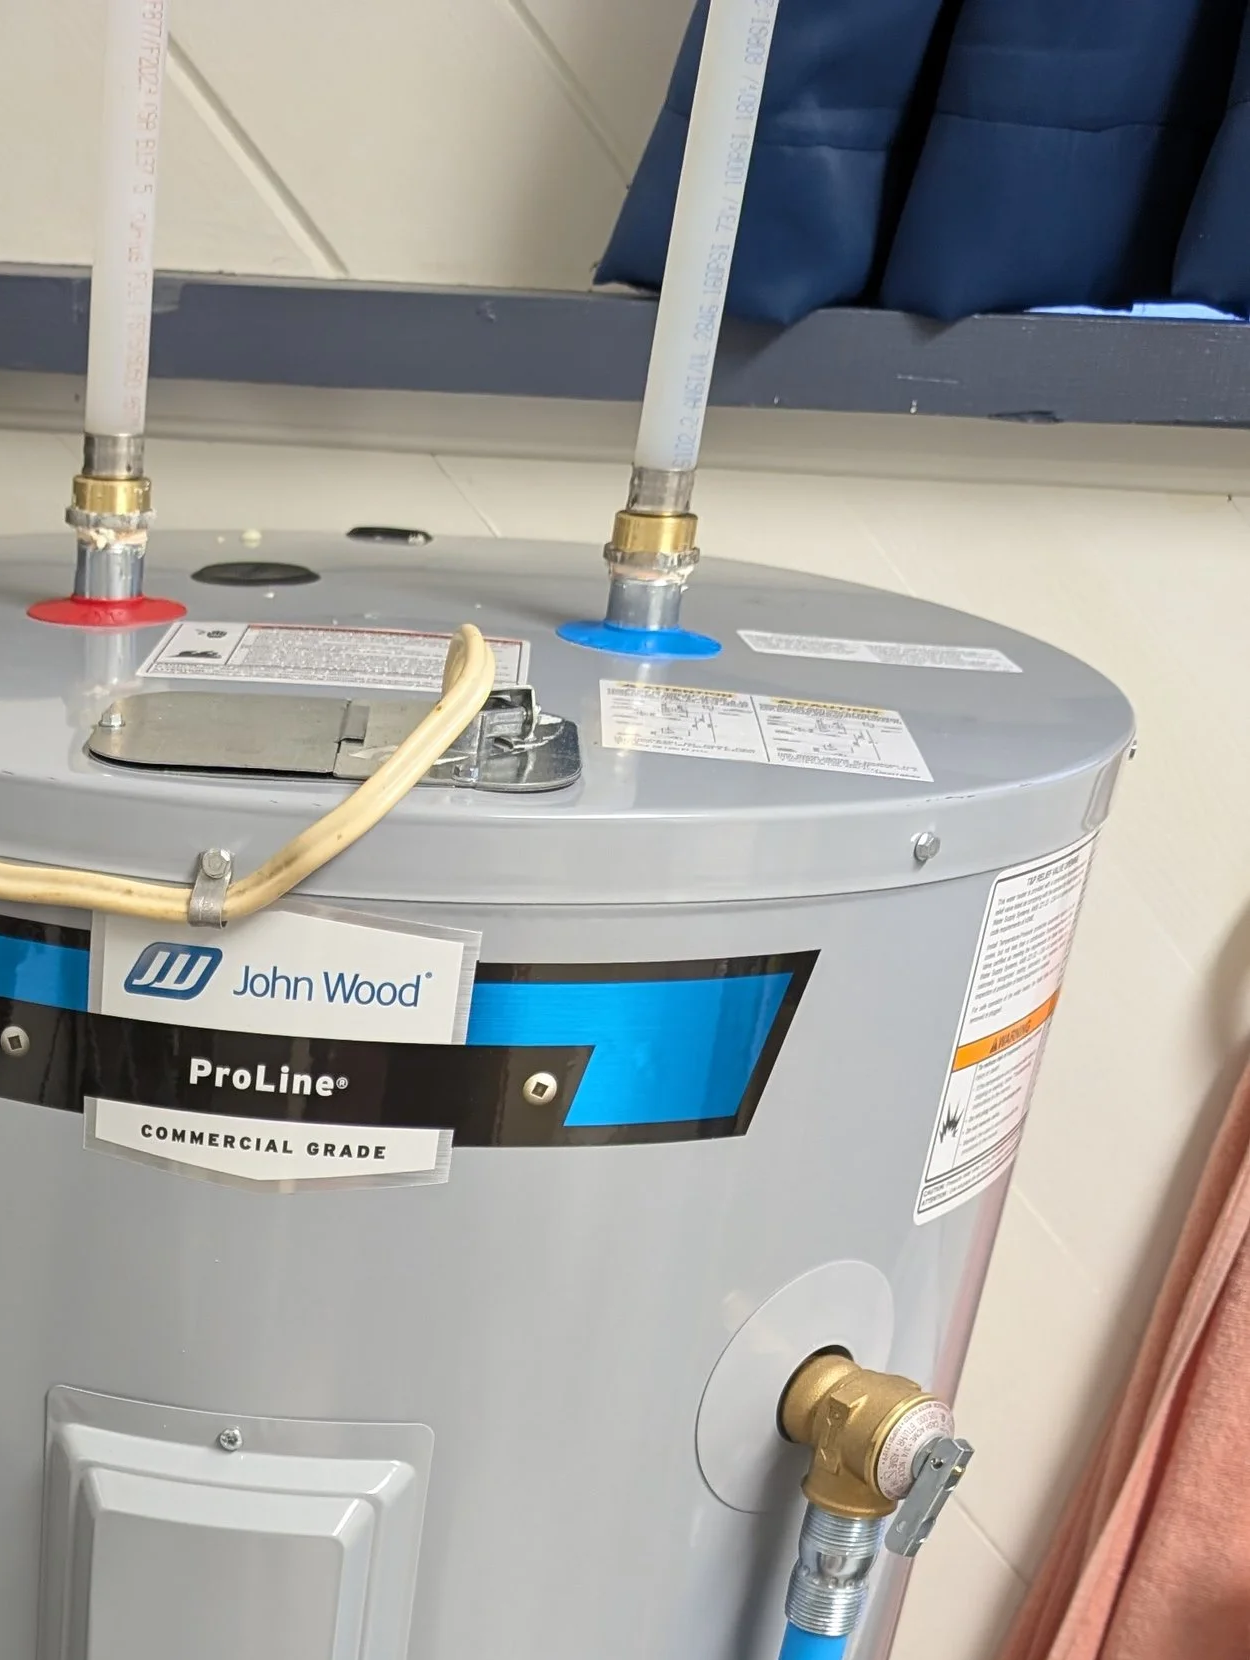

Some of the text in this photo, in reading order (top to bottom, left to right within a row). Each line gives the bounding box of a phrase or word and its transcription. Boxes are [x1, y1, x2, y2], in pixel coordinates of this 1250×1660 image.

[233, 966, 313, 1002] John
[140, 1124, 387, 1160] COMMERCIAL GRADE
